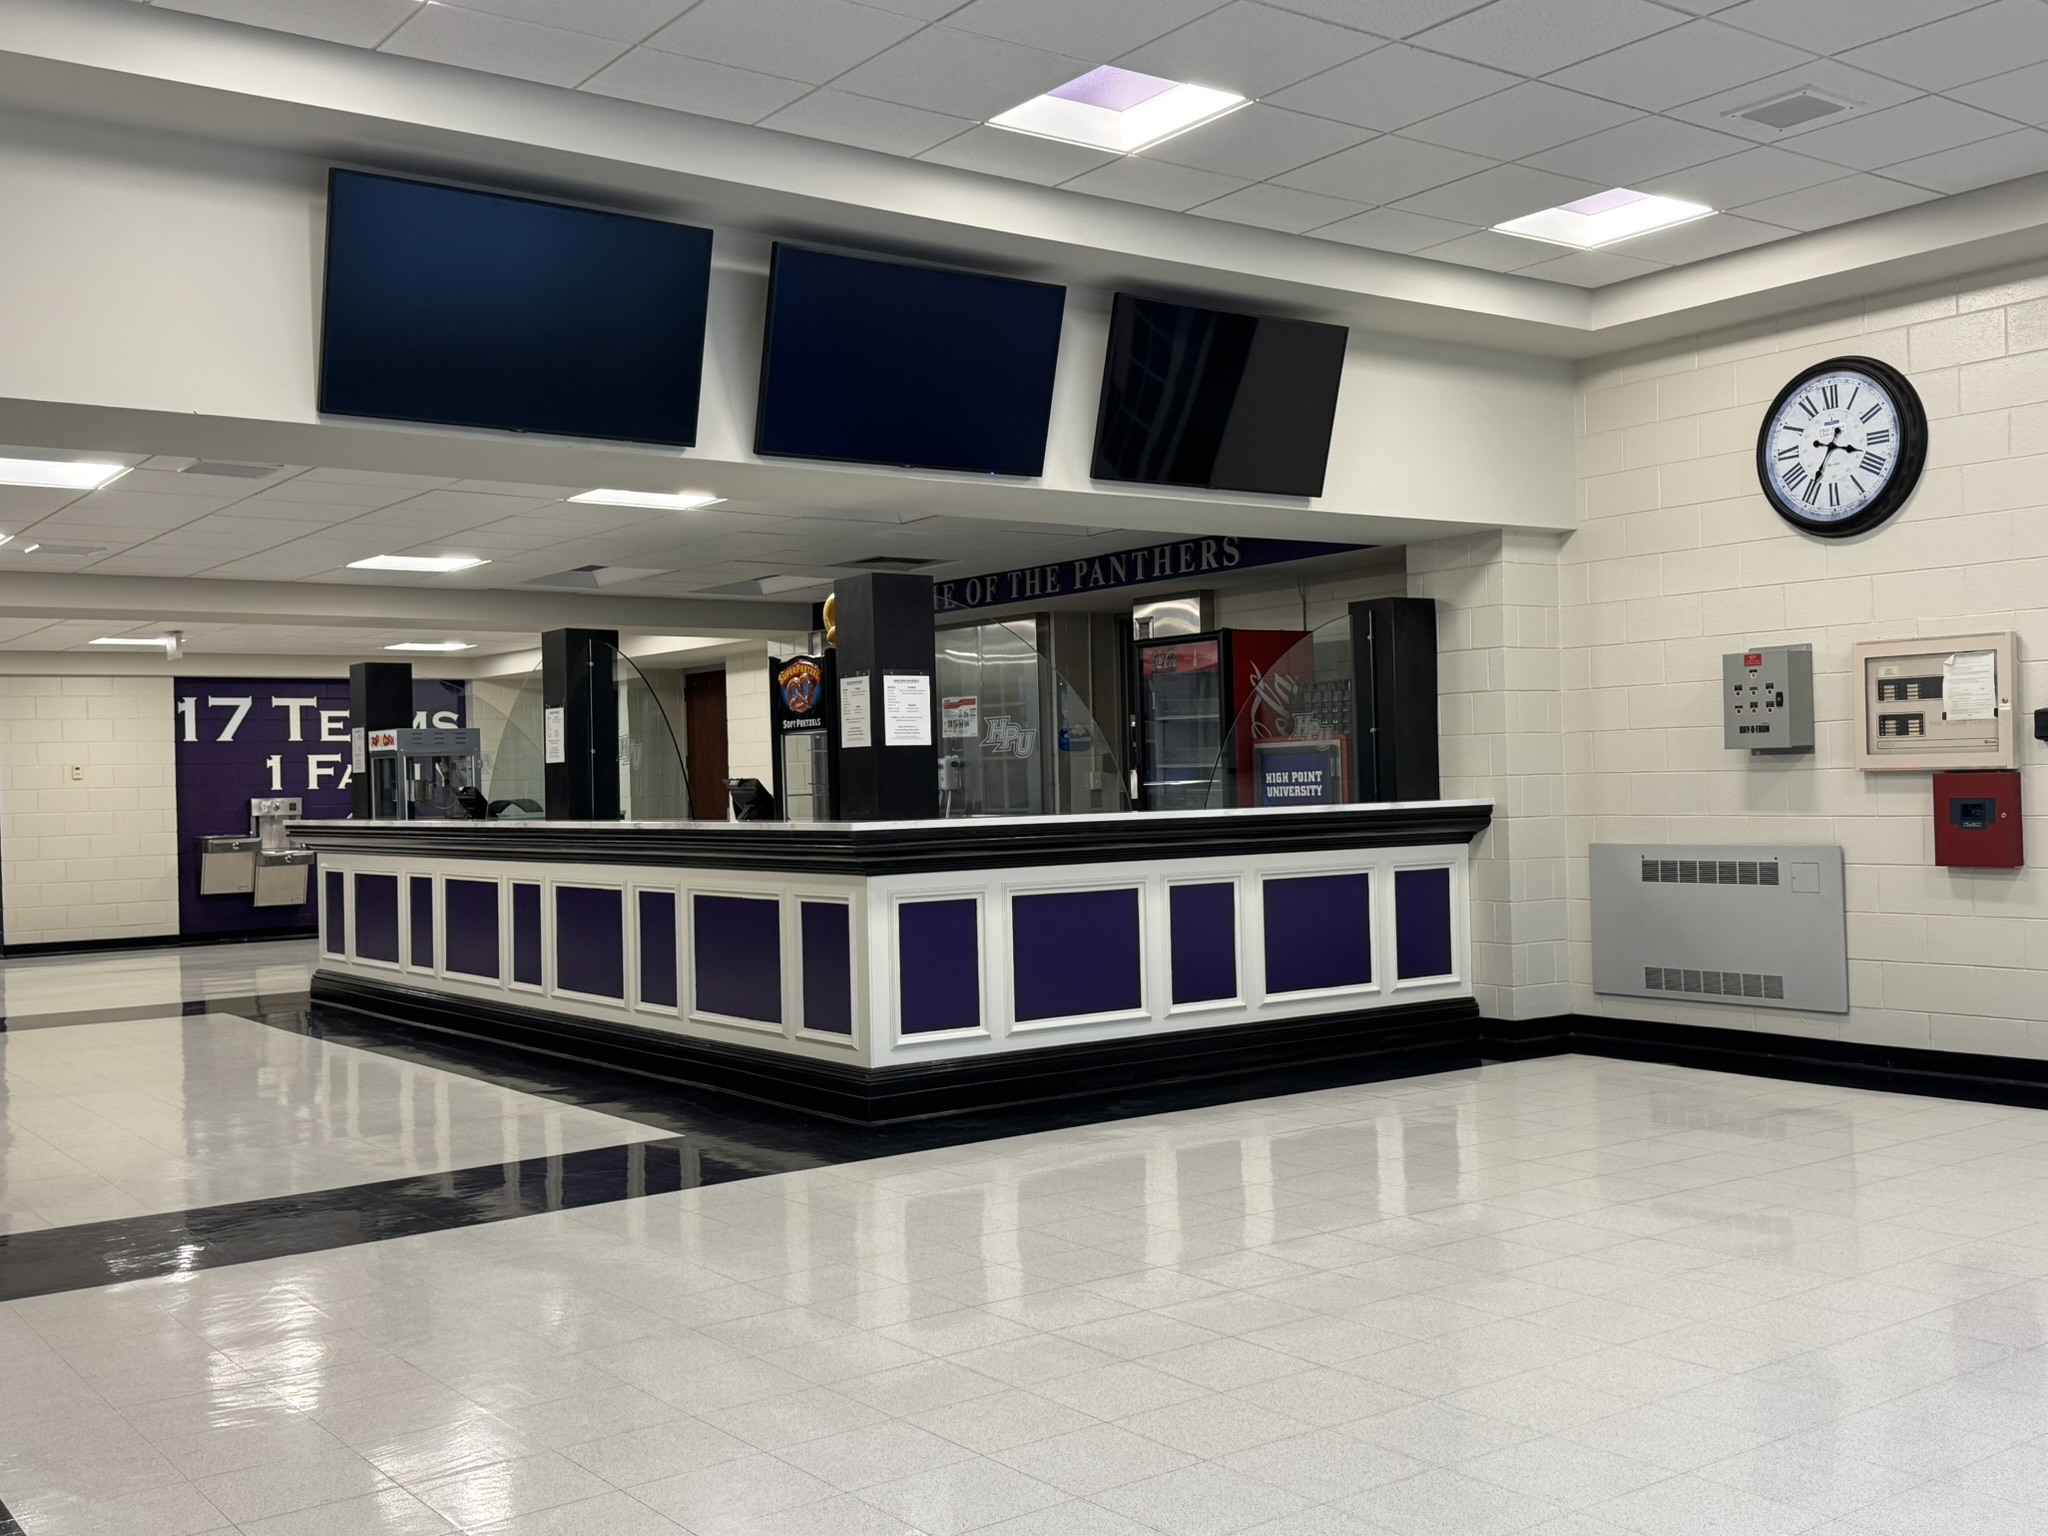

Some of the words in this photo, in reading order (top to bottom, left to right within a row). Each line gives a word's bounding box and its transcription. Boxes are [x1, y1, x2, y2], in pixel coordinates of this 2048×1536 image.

[965, 575, 998, 607] OF
[1007, 565, 1061, 598] THE
[1073, 535, 1242, 589] PANTHERS
[778, 663, 820, 684] SUPERPRETZEL
[177, 695, 253, 742] 17
[782, 719, 796, 729] SOFT
[796, 717, 821, 728] PRETZELS
[979, 715, 1037, 759] HPU
[1287, 711, 1334, 752] HPU
[266, 754, 283, 791] 1
[1265, 771, 1289, 783] HIGH
[1291, 770, 1323, 783] POINT
[1266, 784, 1323, 797] UNIVERSITY
